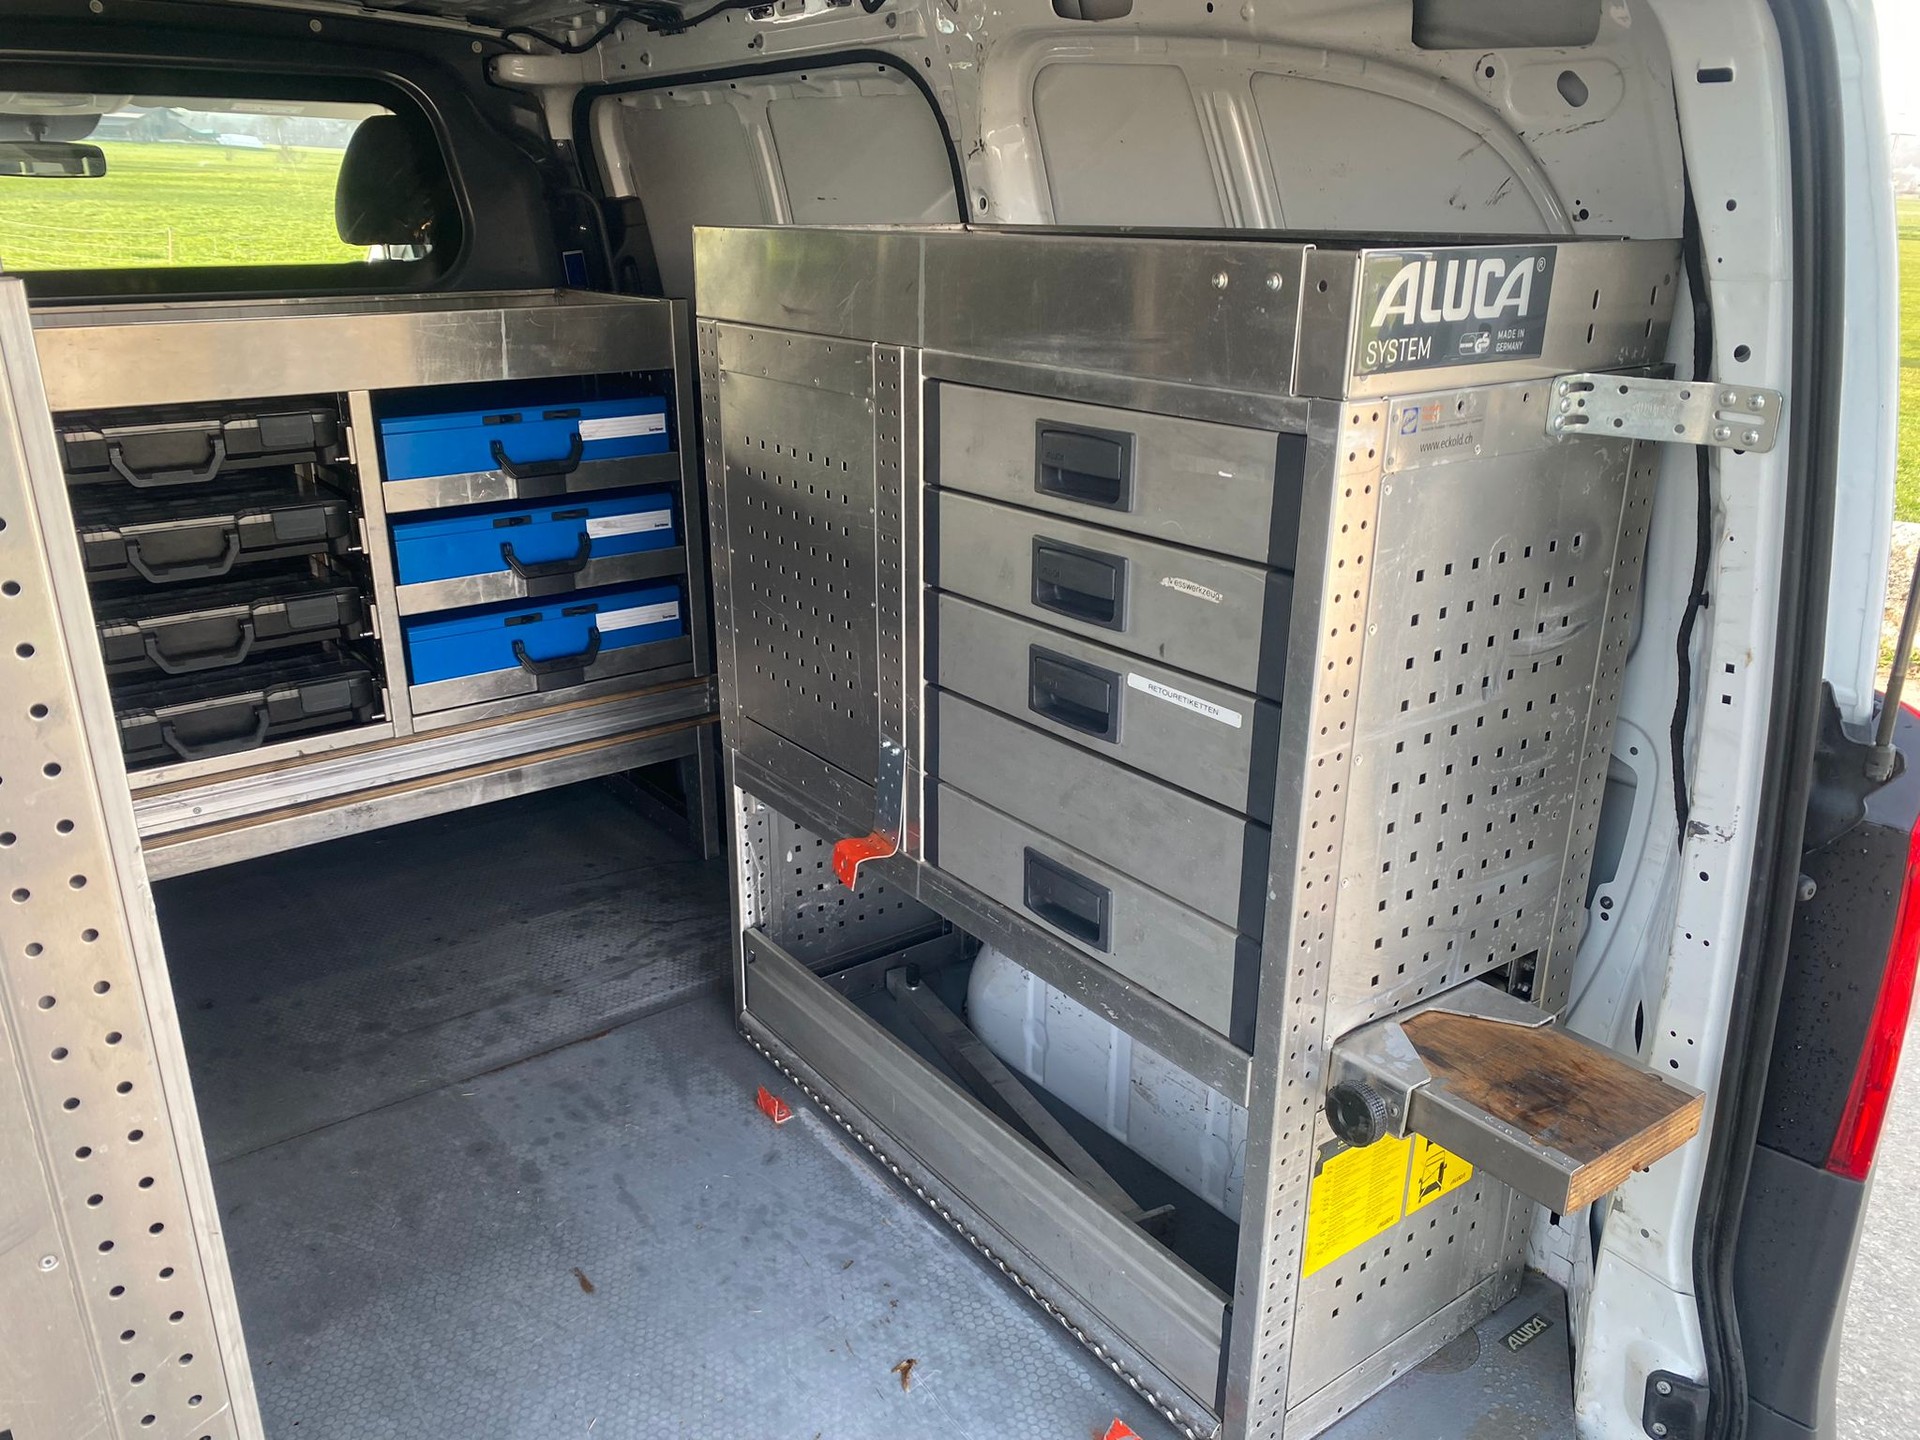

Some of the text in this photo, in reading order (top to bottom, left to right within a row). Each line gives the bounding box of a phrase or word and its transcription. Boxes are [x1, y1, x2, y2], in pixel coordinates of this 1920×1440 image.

[1496, 340, 1524, 353] GERMANY
[1497, 328, 1526, 340] MADE IN
[1366, 336, 1432, 365] SYSTEM
[1419, 432, 1474, 453] www.eckold.ch
[1148, 683, 1220, 716] RETOURETIKETTEN
[1508, 1316, 1547, 1350] ALUCA
